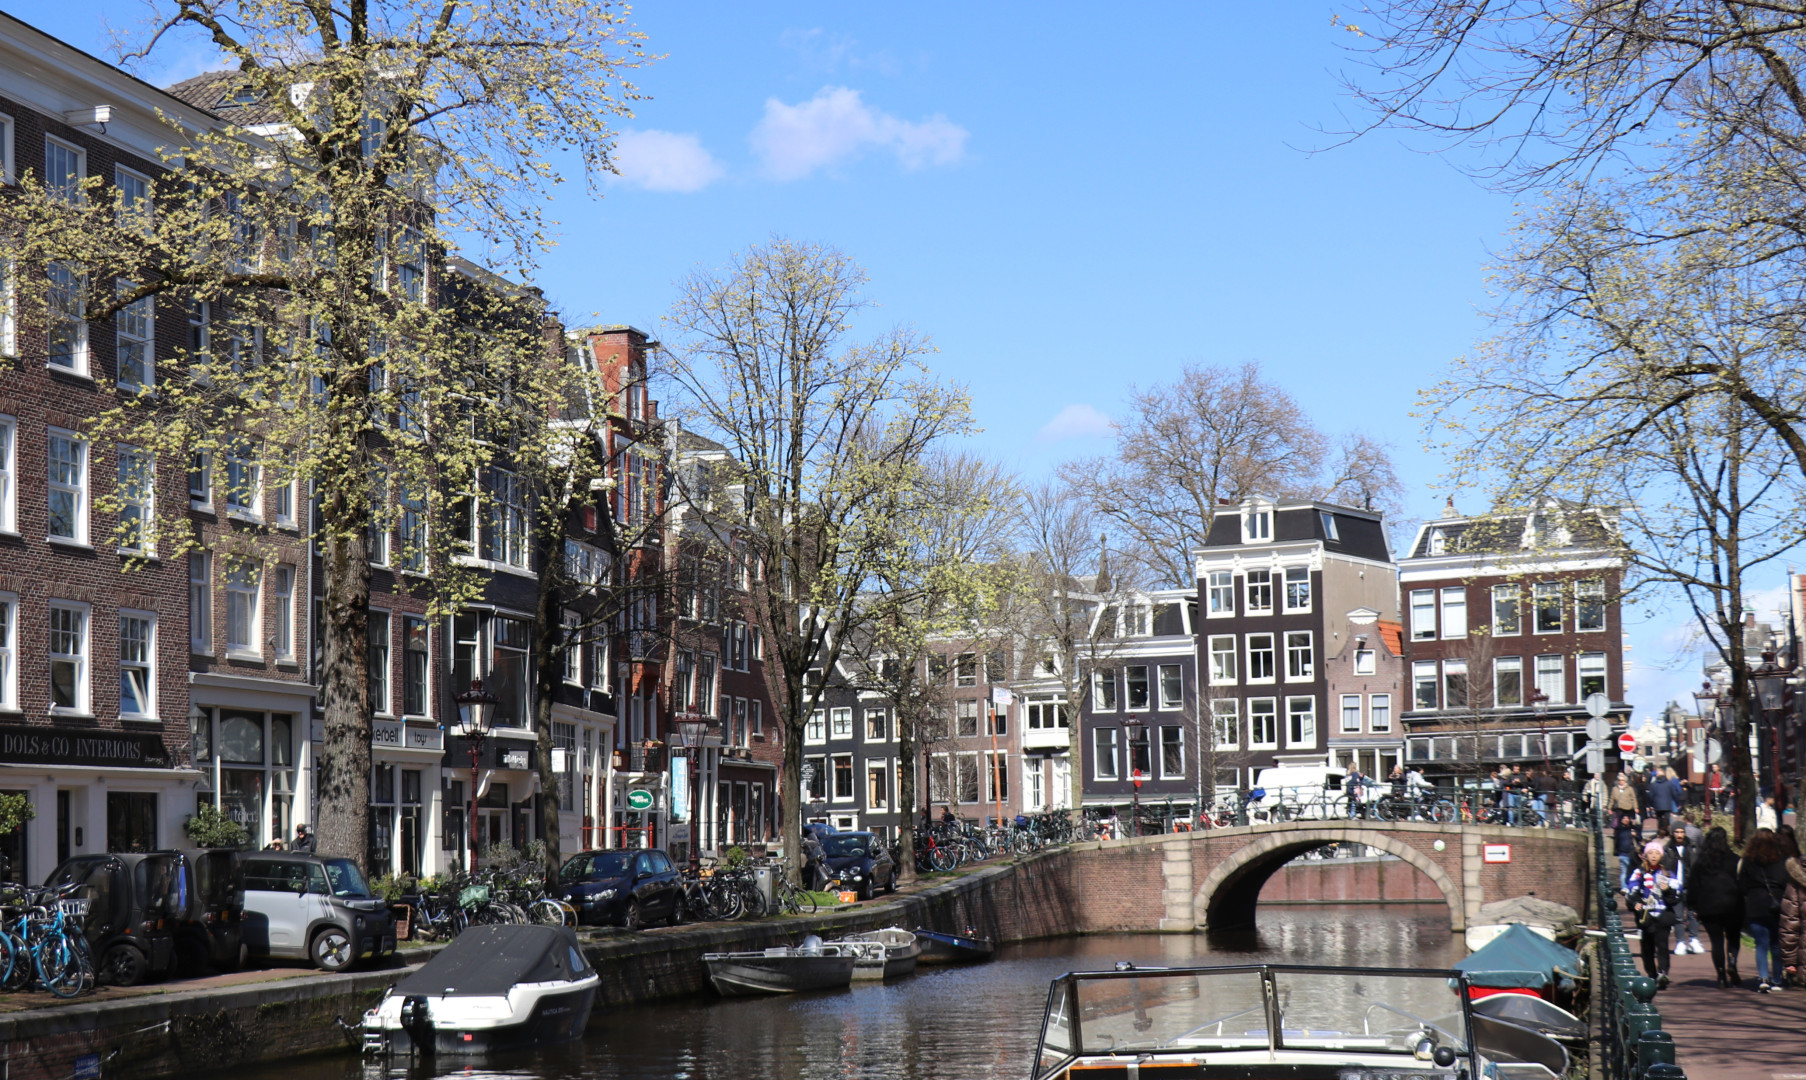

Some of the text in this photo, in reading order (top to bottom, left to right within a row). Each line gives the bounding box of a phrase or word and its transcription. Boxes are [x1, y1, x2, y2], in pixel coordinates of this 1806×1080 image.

[372, 725, 399, 743] kerbell
[414, 731, 427, 746] toys
[4, 734, 39, 755] DOLS
[42, 740, 50, 756] &
[51, 736, 69, 757] CO
[76, 738, 141, 760] INTERIORS
